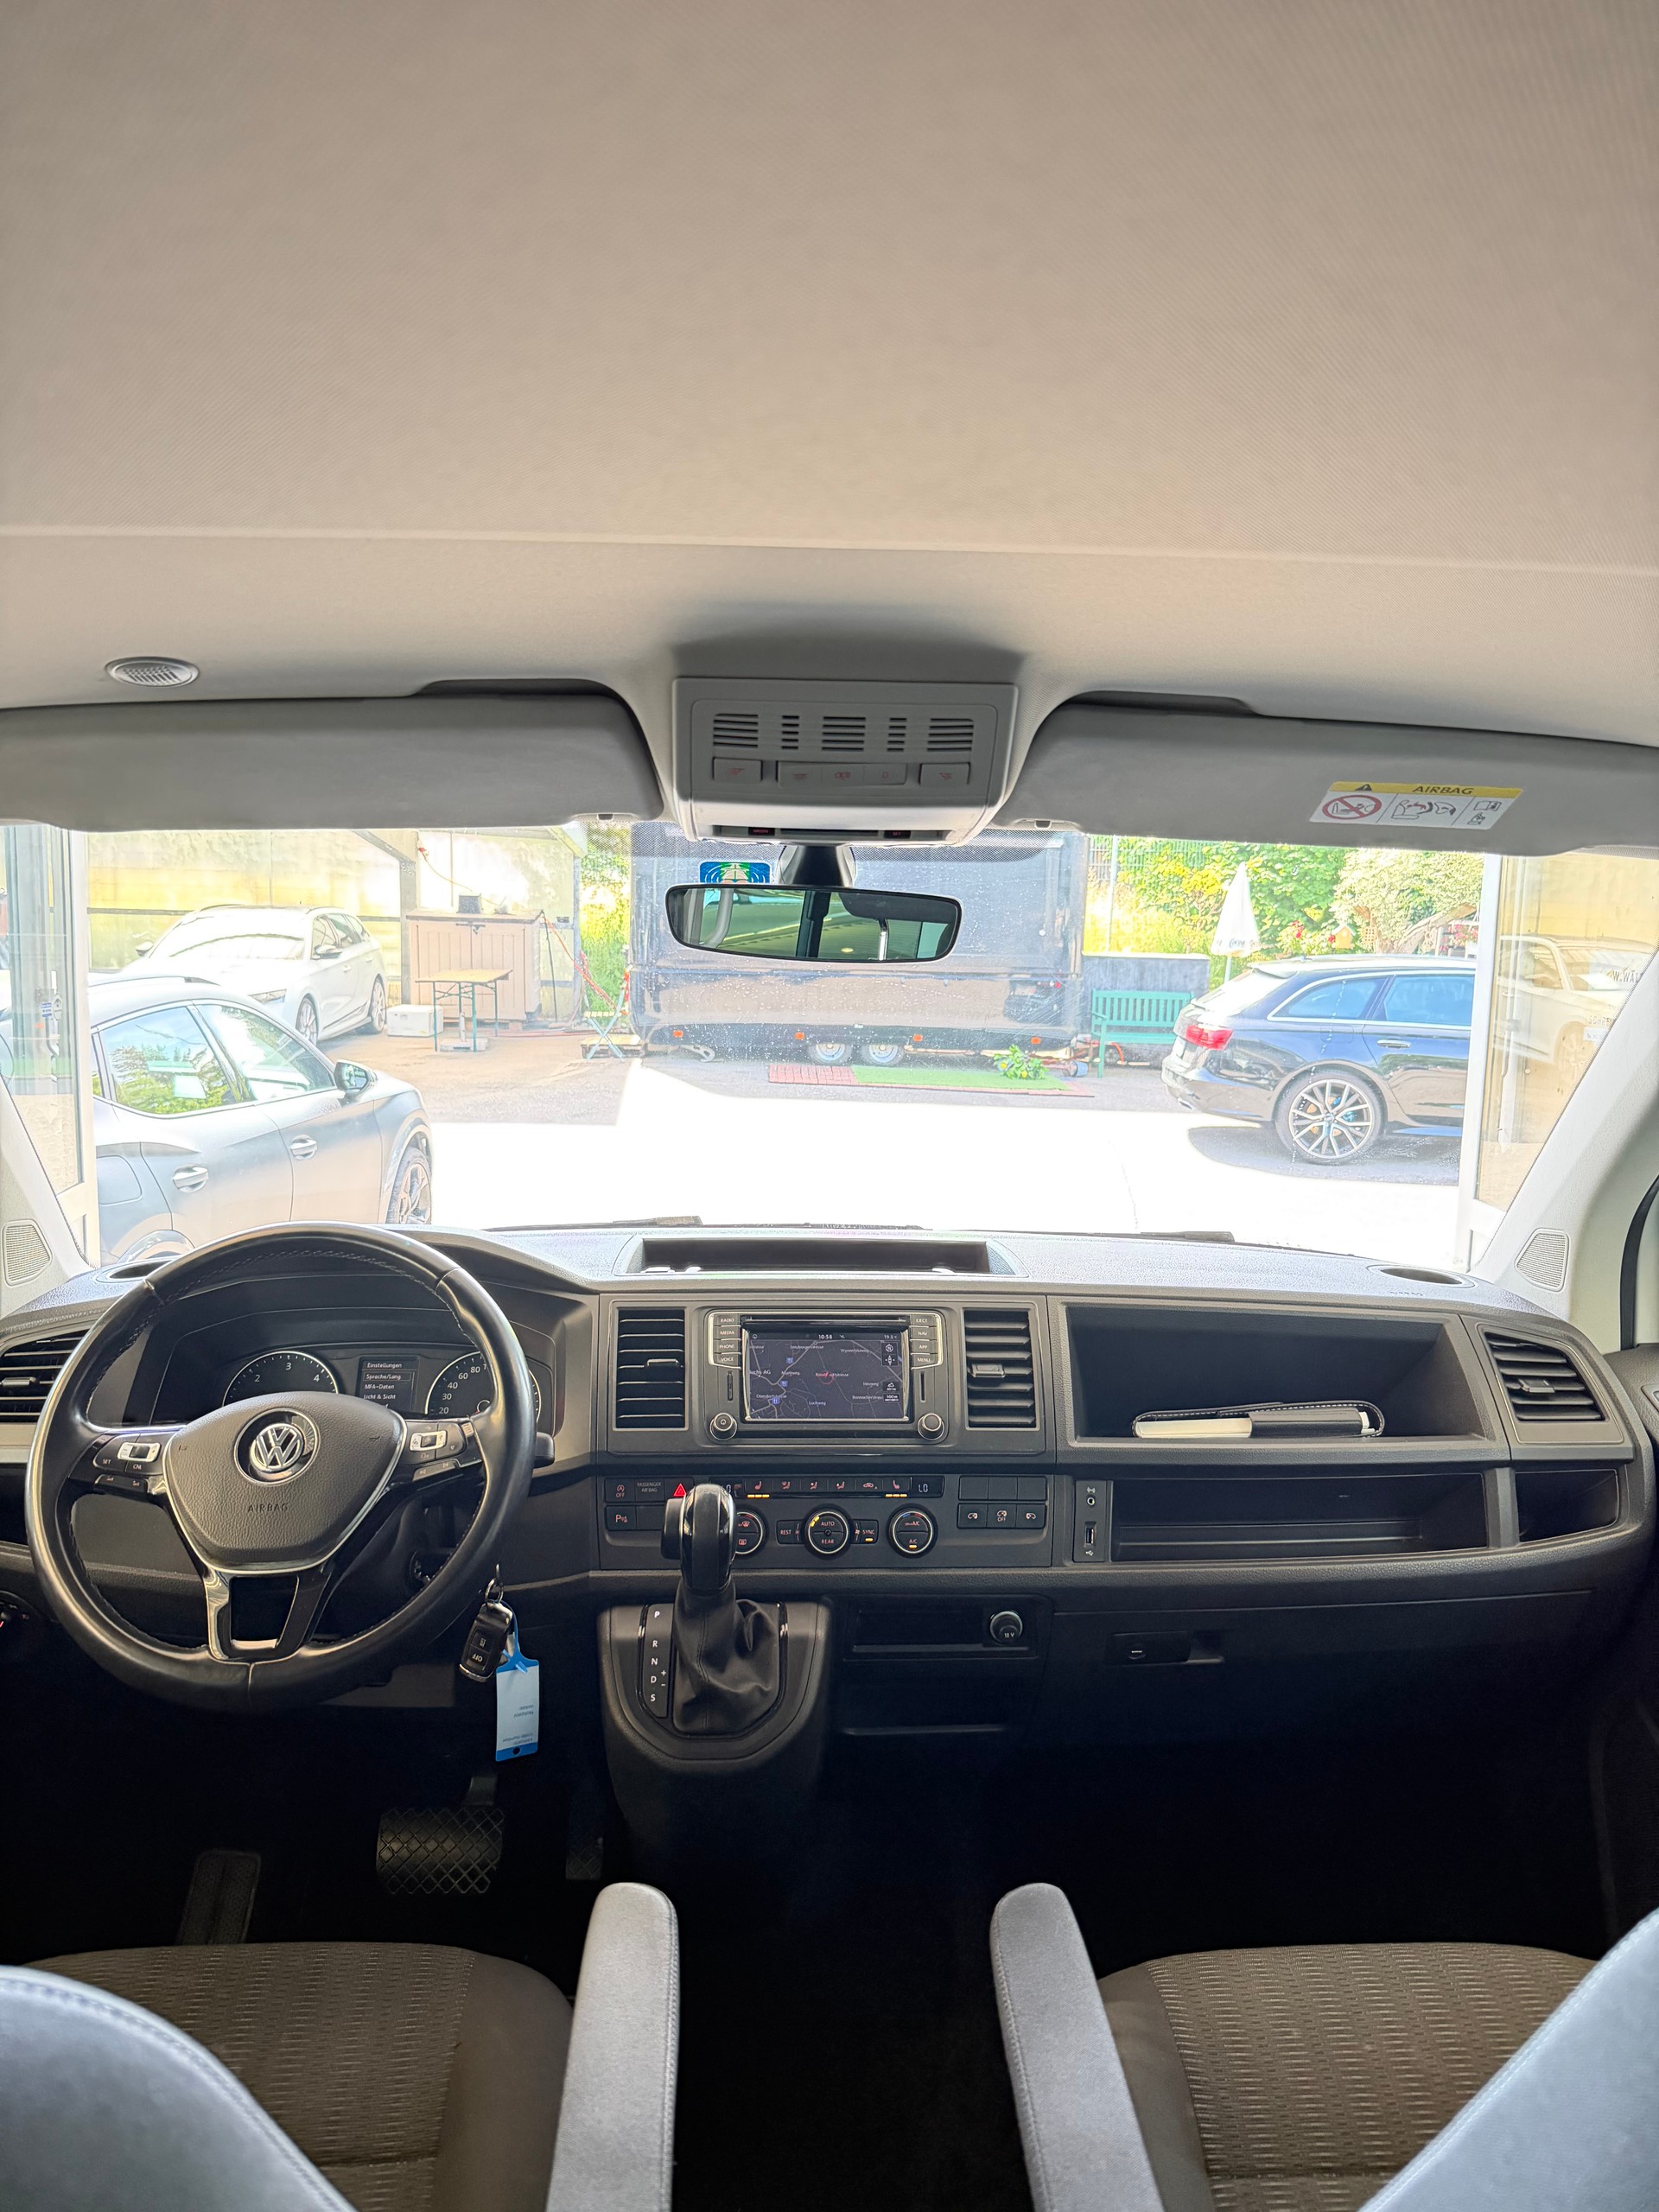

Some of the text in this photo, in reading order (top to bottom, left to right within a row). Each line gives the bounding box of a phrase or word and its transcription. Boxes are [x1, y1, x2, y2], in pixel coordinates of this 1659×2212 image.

[1413, 785, 1474, 795] AIRBAG
[314, 1374, 320, 1382] 4
[250, 1423, 303, 1472] VW
[248, 1503, 289, 1513] AIRBAG
